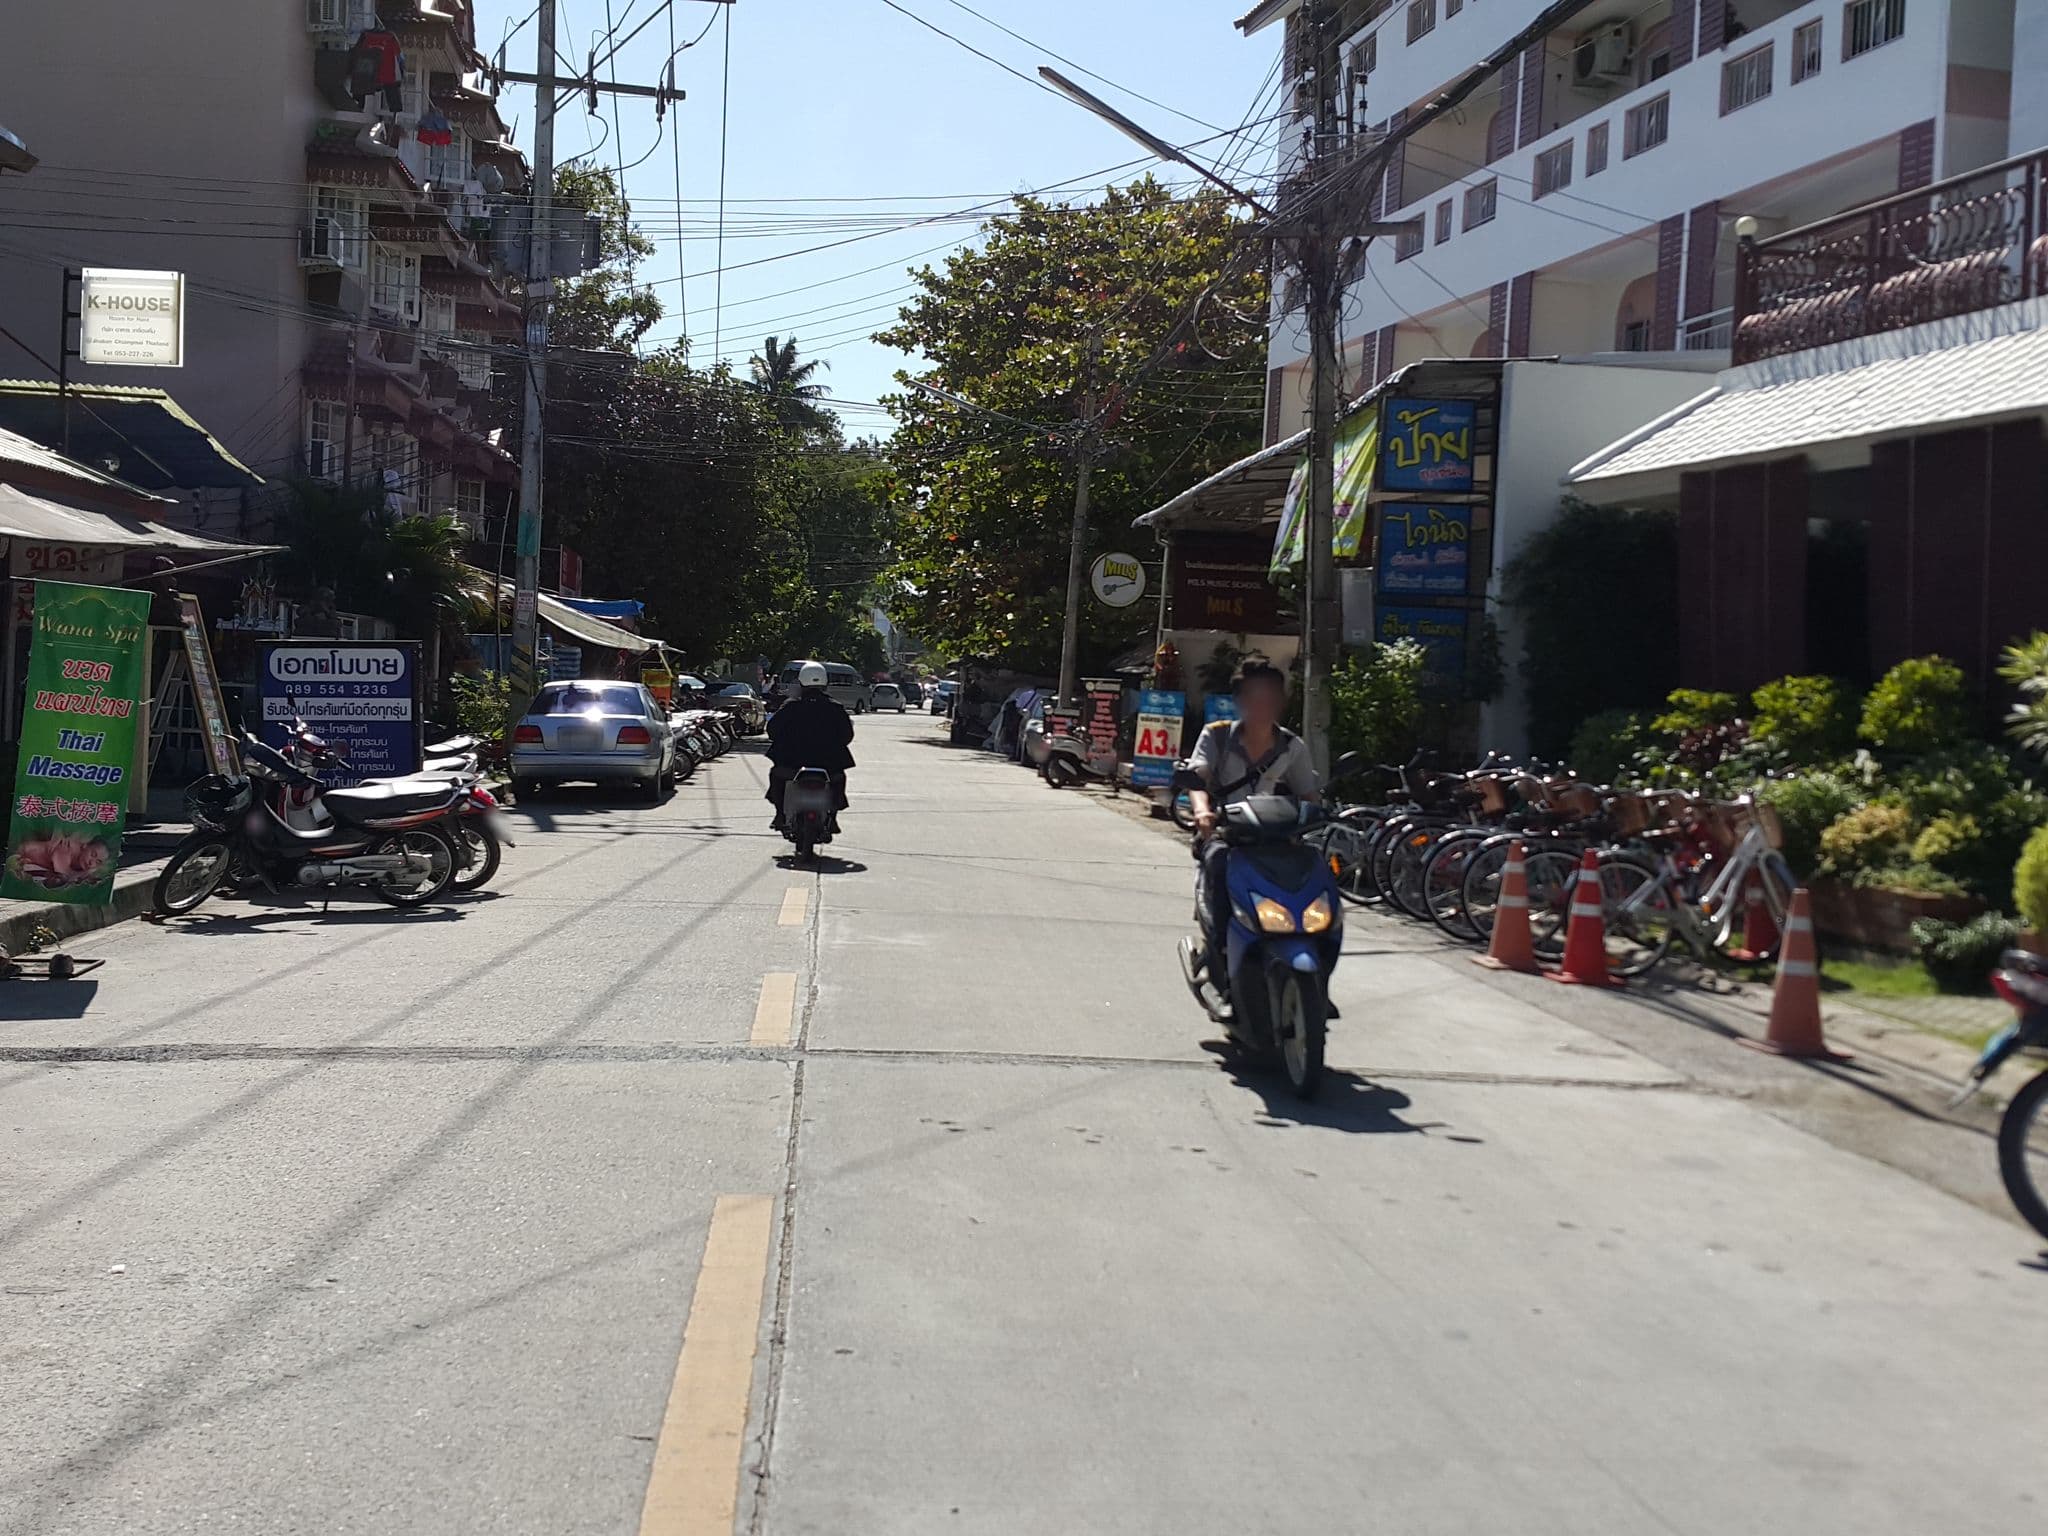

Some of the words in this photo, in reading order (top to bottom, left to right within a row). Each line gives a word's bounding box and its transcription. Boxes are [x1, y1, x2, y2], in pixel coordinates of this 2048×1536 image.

[87, 294, 171, 312] K-HOUSE
[1389, 407, 1469, 469] ป้าย
[39, 615, 95, 638] Wana
[105, 623, 140, 645] Spa
[62, 658, 113, 682] นวด
[33, 685, 134, 718] แผนไทย
[285, 684, 312, 695] 089
[319, 684, 345, 695] 554
[353, 684, 389, 695] 3236
[57, 728, 106, 753] Thai
[26, 754, 124, 785] Massage
[16, 794, 120, 824] 泰式按摩
